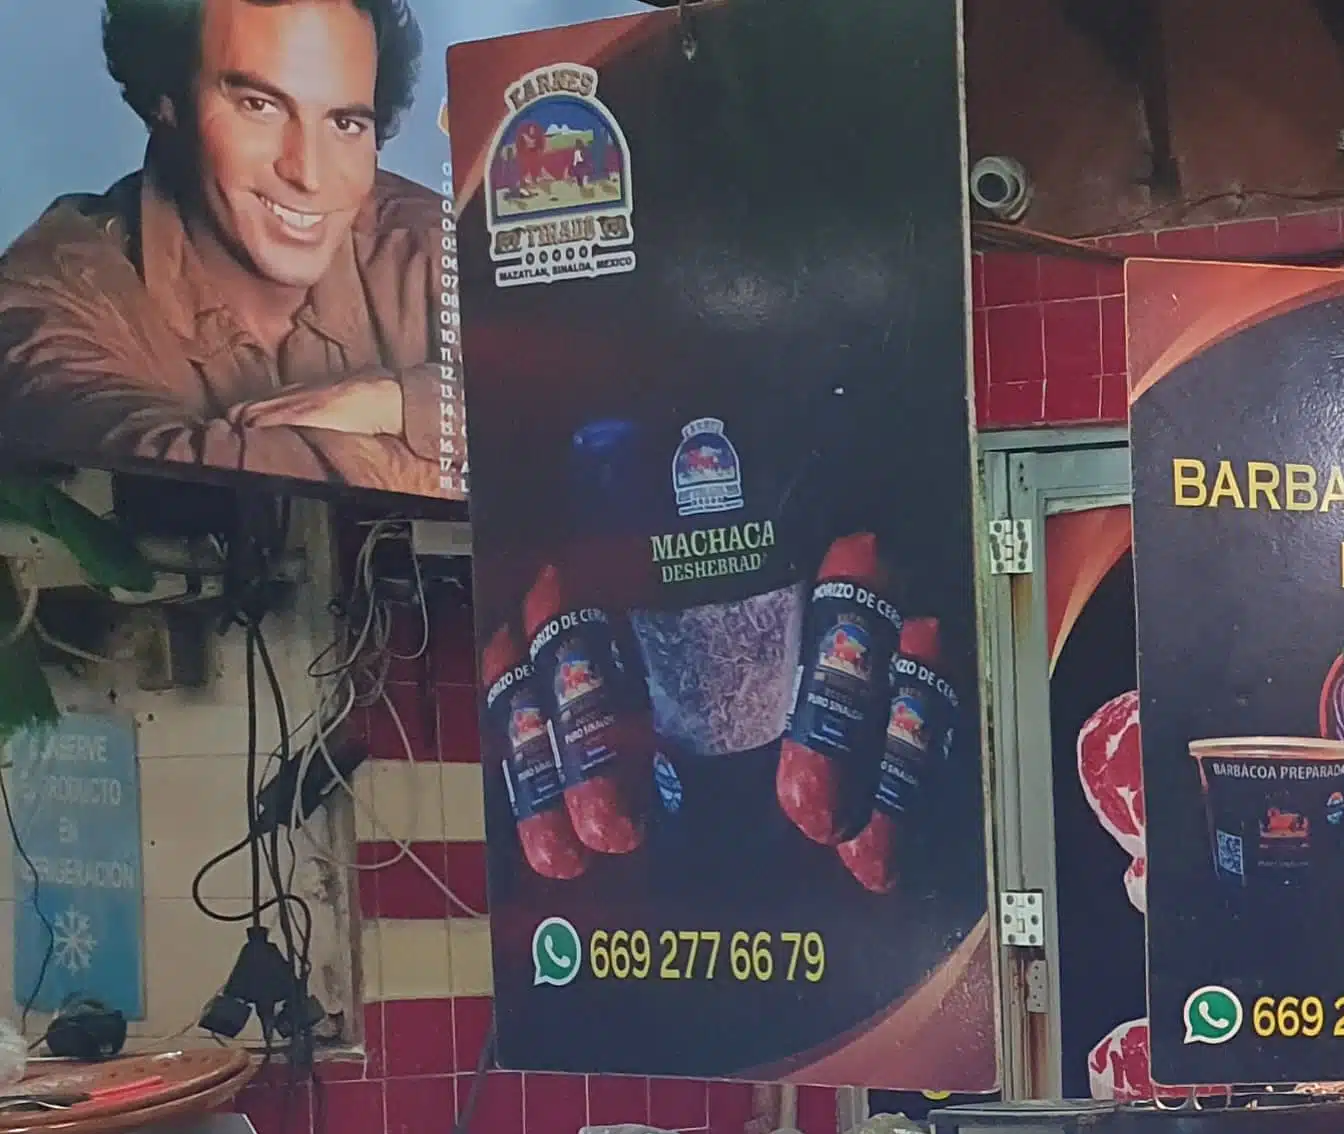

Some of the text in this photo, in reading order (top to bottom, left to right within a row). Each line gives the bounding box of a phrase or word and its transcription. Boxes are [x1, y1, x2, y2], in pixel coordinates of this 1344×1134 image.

[650, 520, 776, 562] MACHACA
[1212, 763, 1277, 780] BARBACOA
[589, 929, 825, 982] 669 277 66 79
[1252, 995, 1325, 1038] 669
